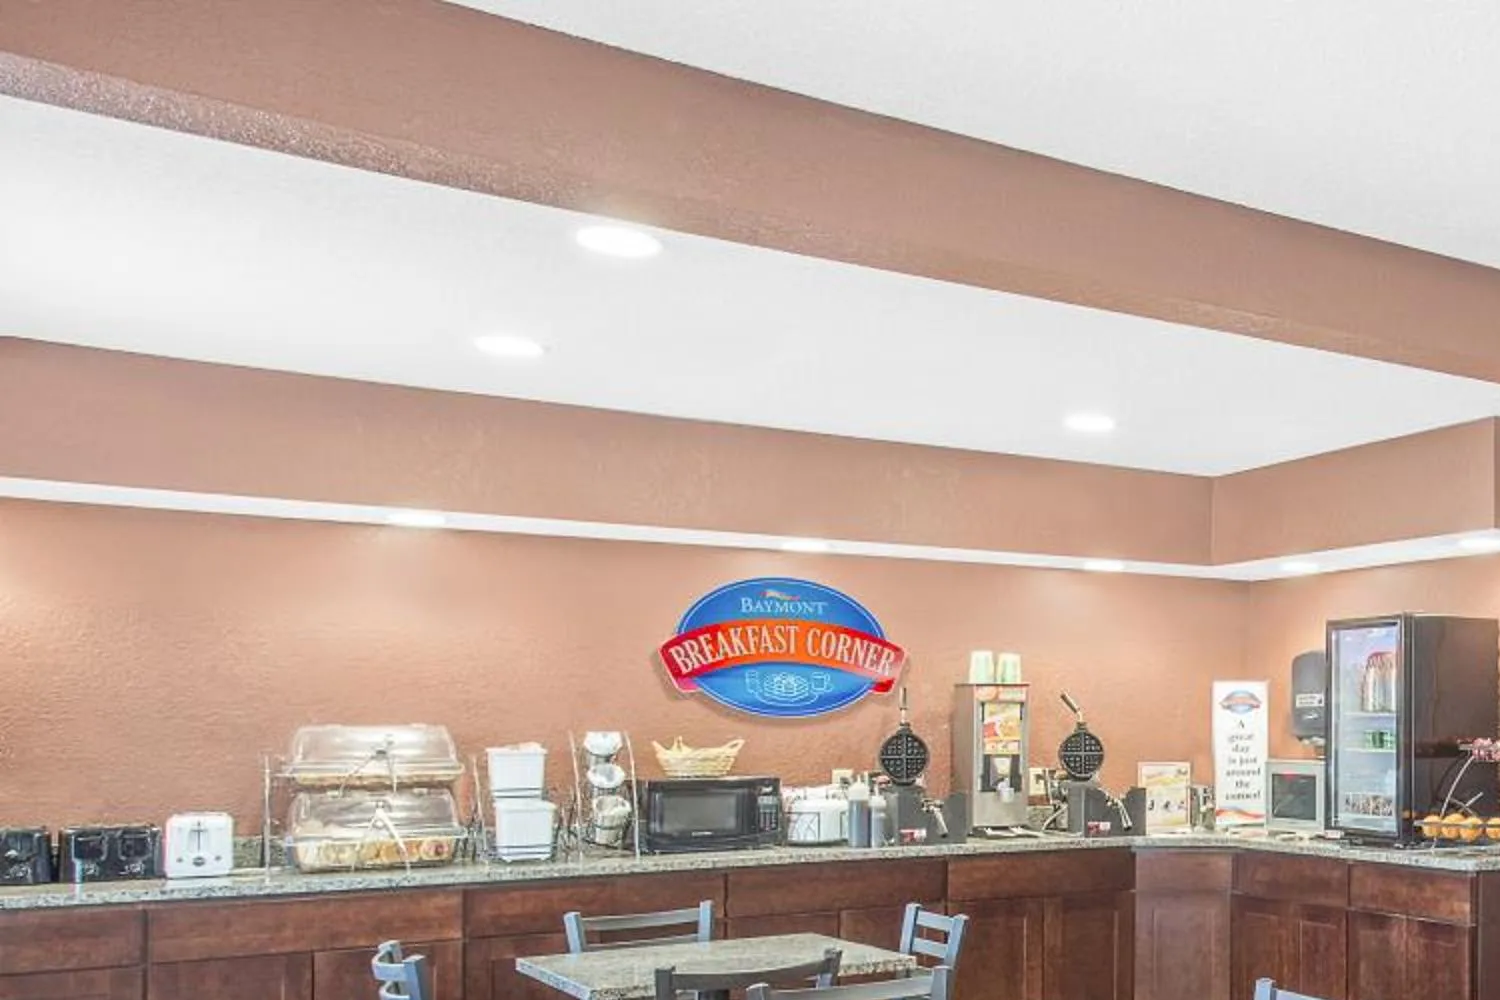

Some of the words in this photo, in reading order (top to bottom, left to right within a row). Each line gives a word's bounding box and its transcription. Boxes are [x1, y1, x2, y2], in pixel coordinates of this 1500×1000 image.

[740, 597, 829, 616] BAYMONT
[668, 625, 800, 676] BREAKFAST
[806, 627, 896, 677] CORNER
